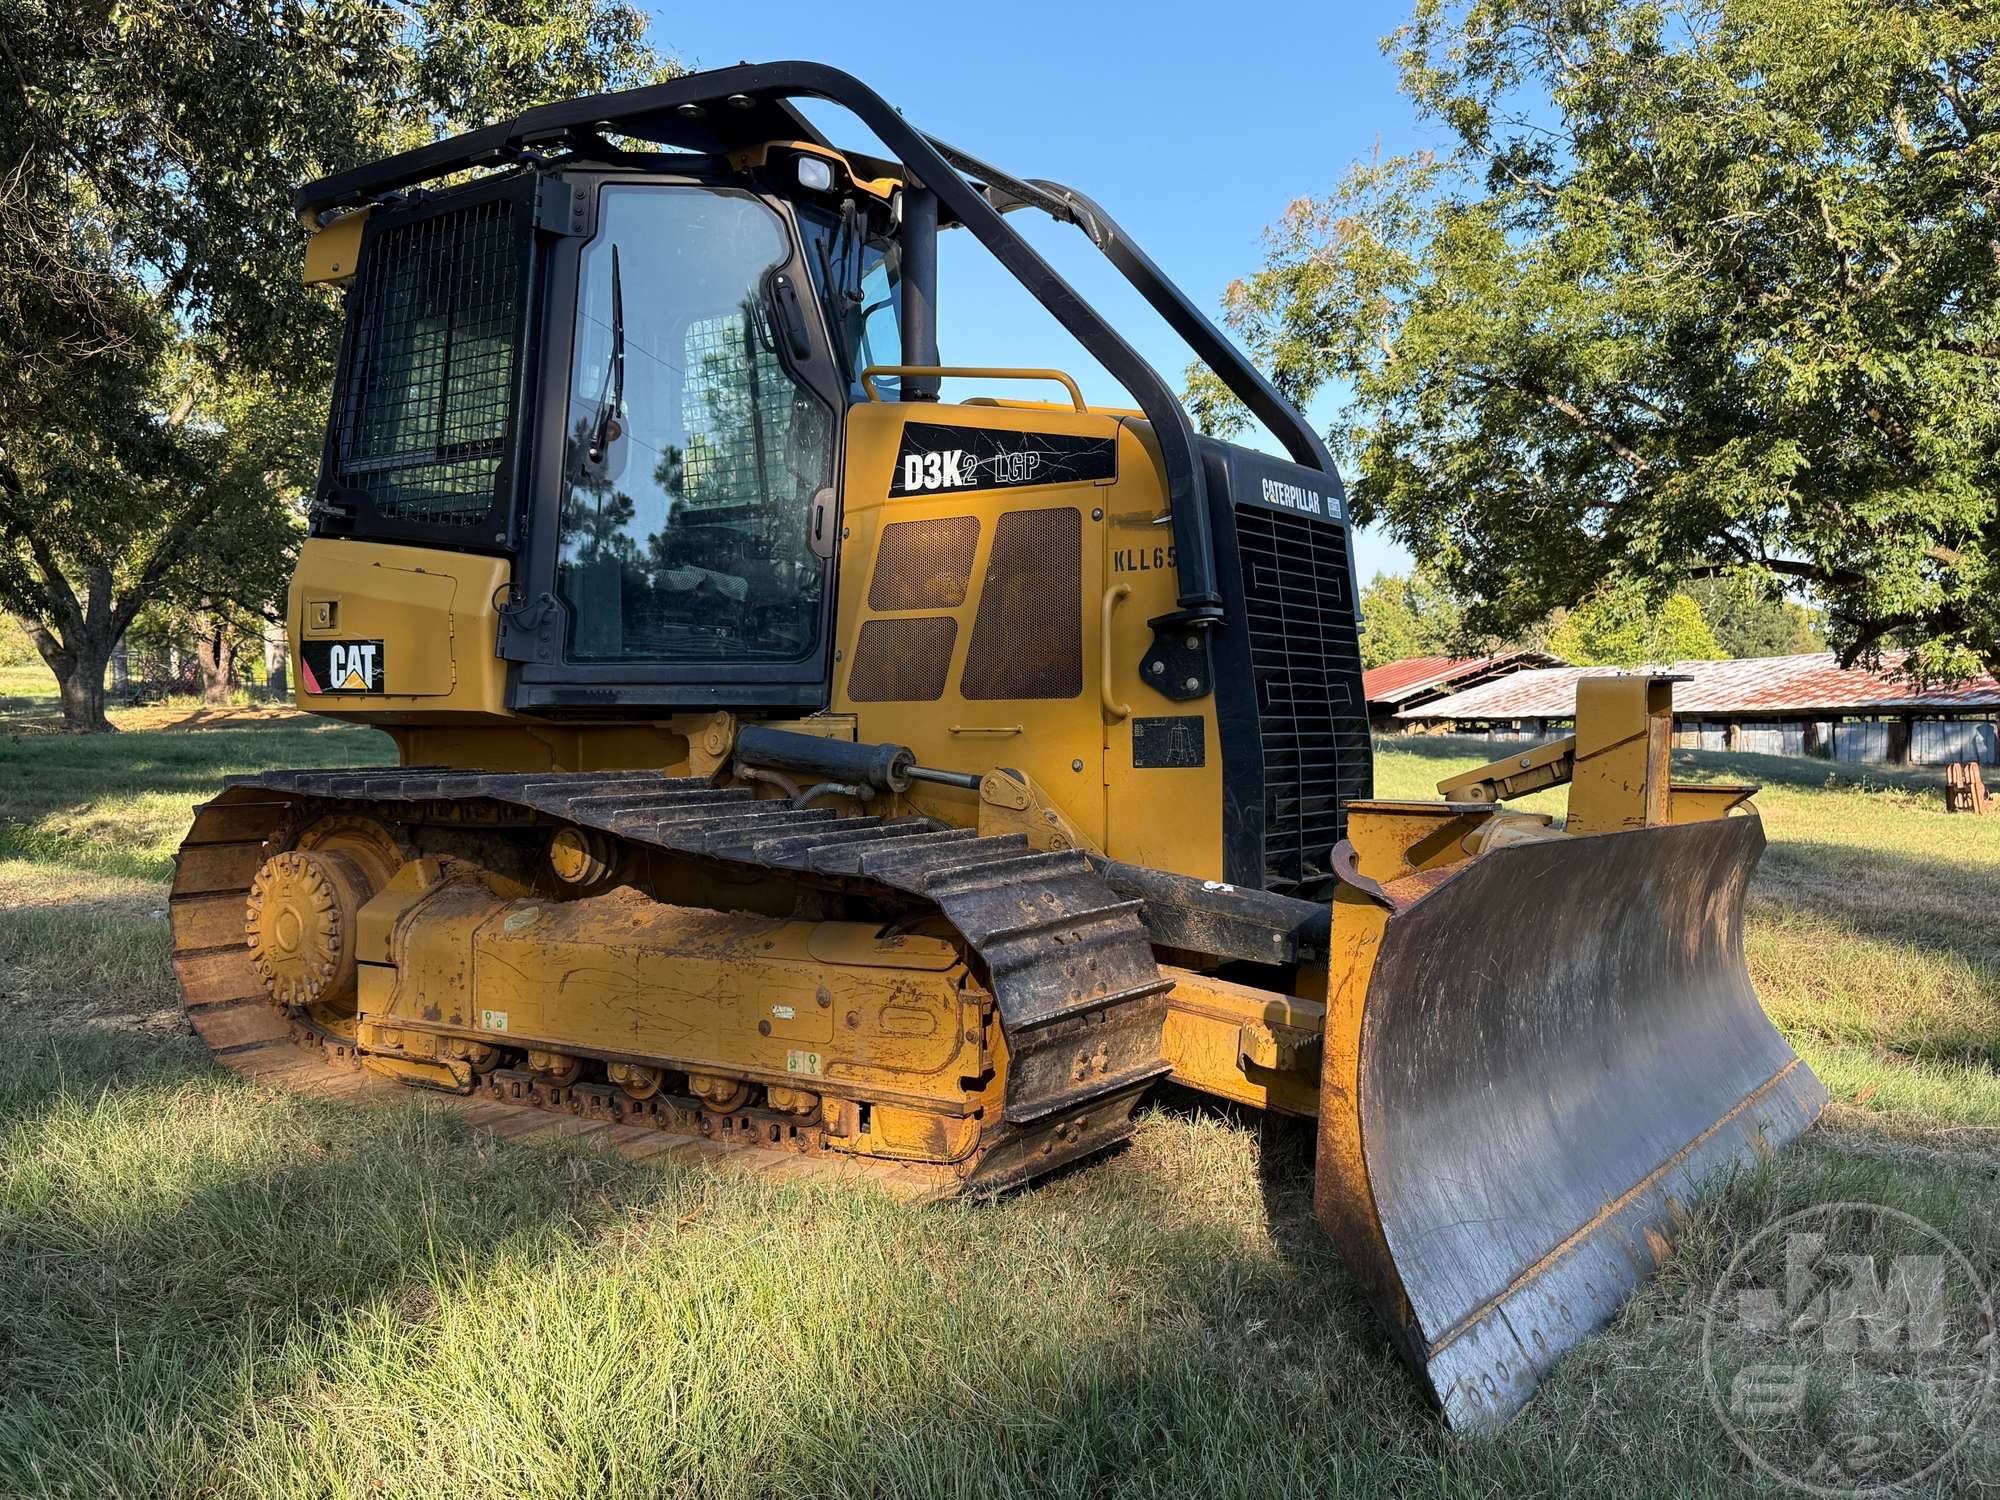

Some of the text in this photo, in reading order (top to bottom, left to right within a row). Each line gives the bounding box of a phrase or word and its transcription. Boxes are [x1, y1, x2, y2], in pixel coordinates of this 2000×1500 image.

[995, 451, 1040, 484] LGP
[1262, 478, 1321, 515] CATERPILLAR
[330, 644, 376, 689] CAT
